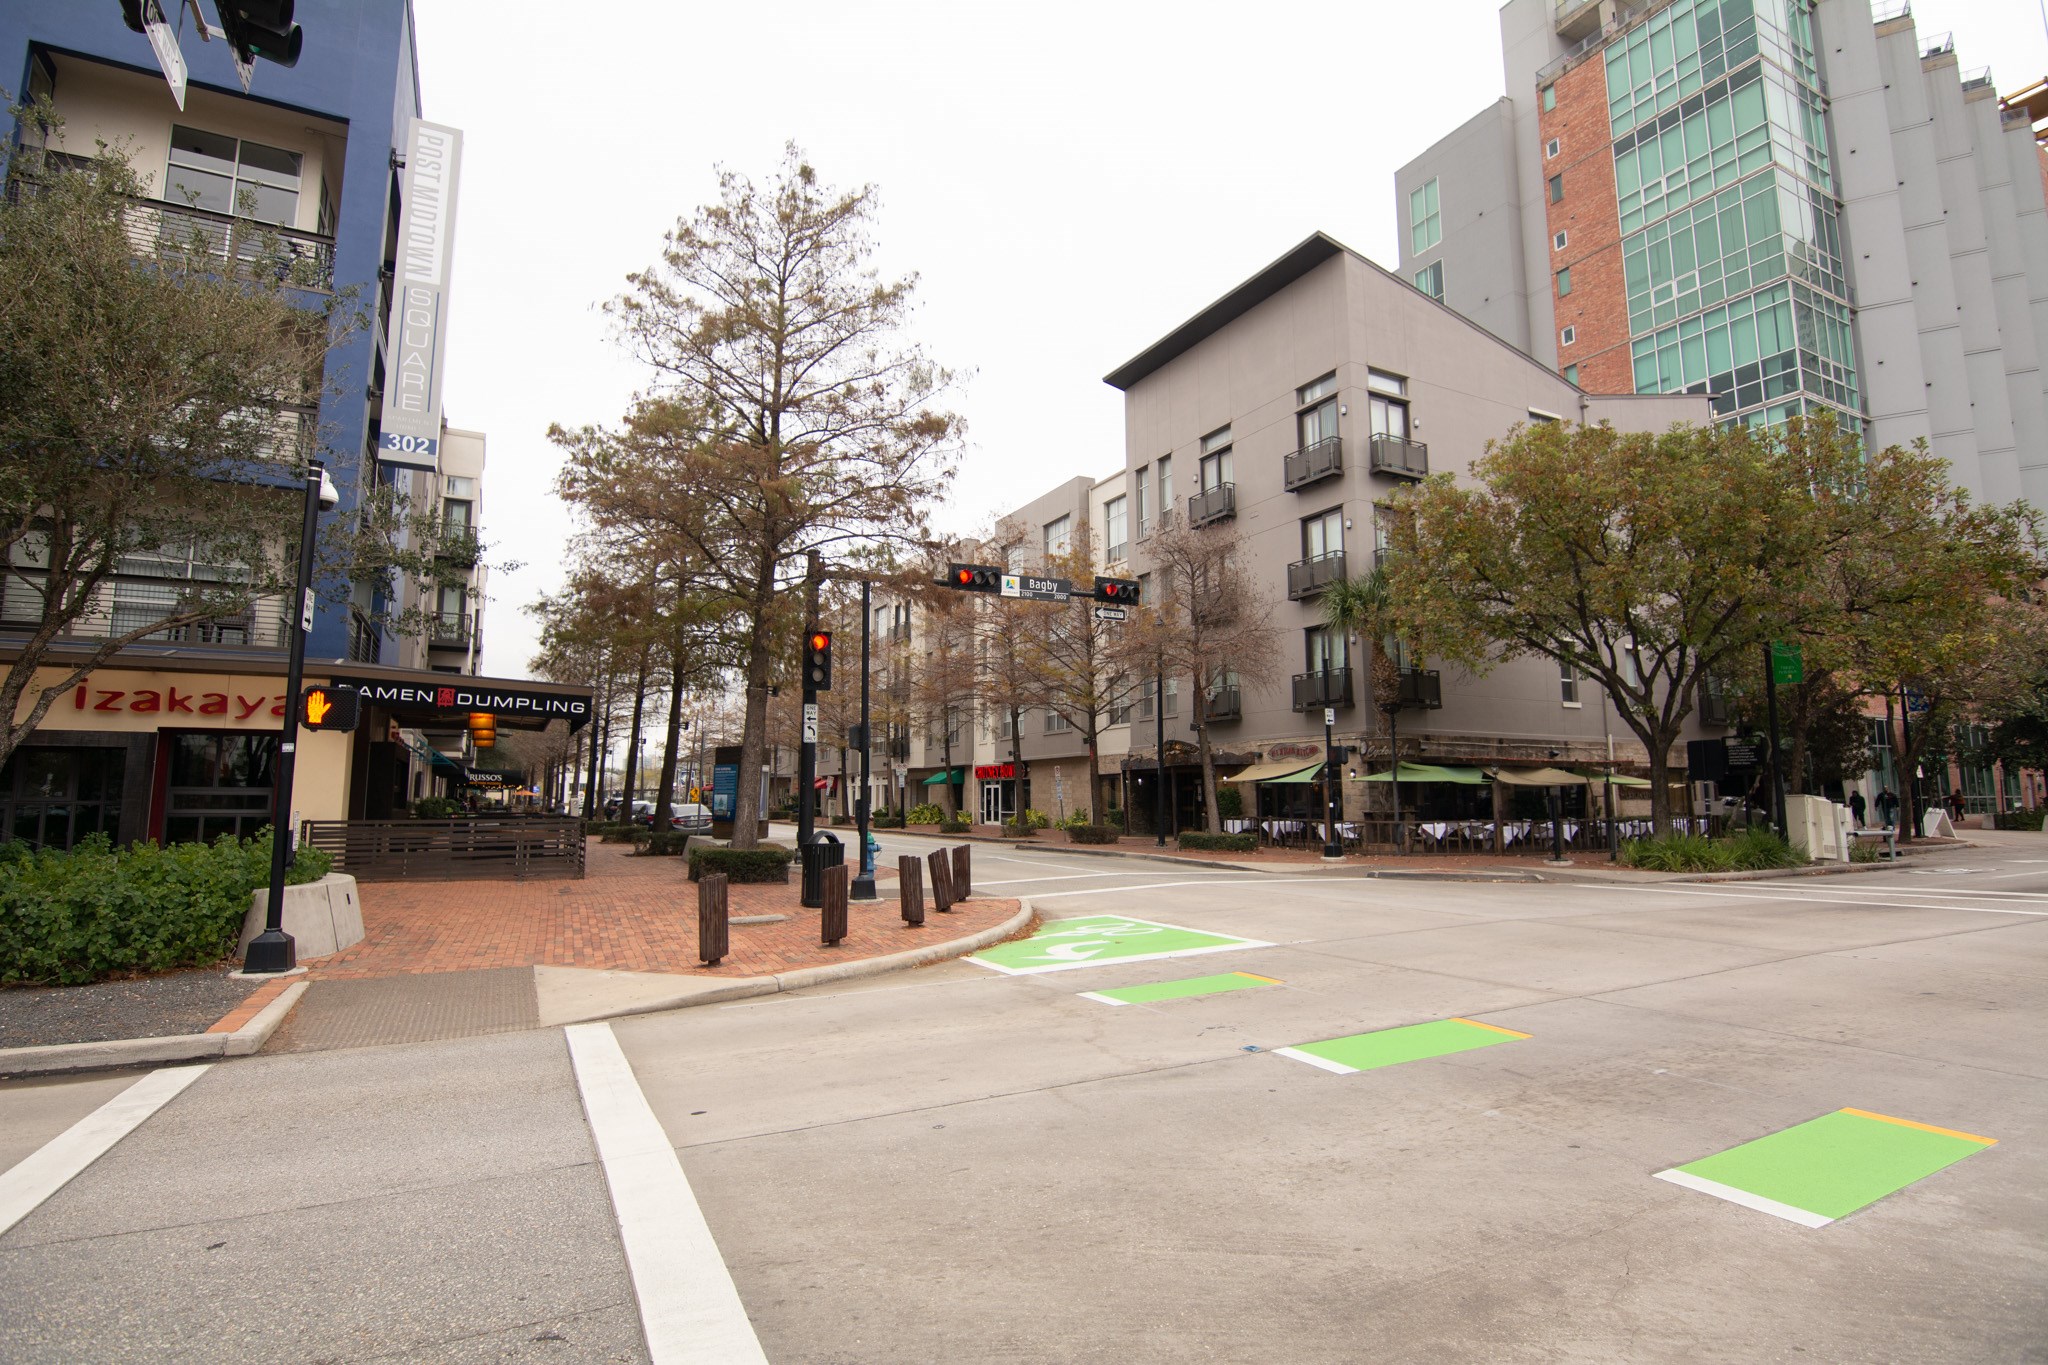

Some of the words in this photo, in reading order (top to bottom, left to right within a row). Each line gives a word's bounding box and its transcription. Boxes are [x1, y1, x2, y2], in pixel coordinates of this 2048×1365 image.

[415, 135, 445, 183] POST
[405, 186, 440, 278] MIDTOWN
[402, 288, 431, 412] SQUARE
[388, 434, 429, 454] 302
[1029, 579, 1058, 592] Bagby
[457, 694, 585, 714] DUMPLING
